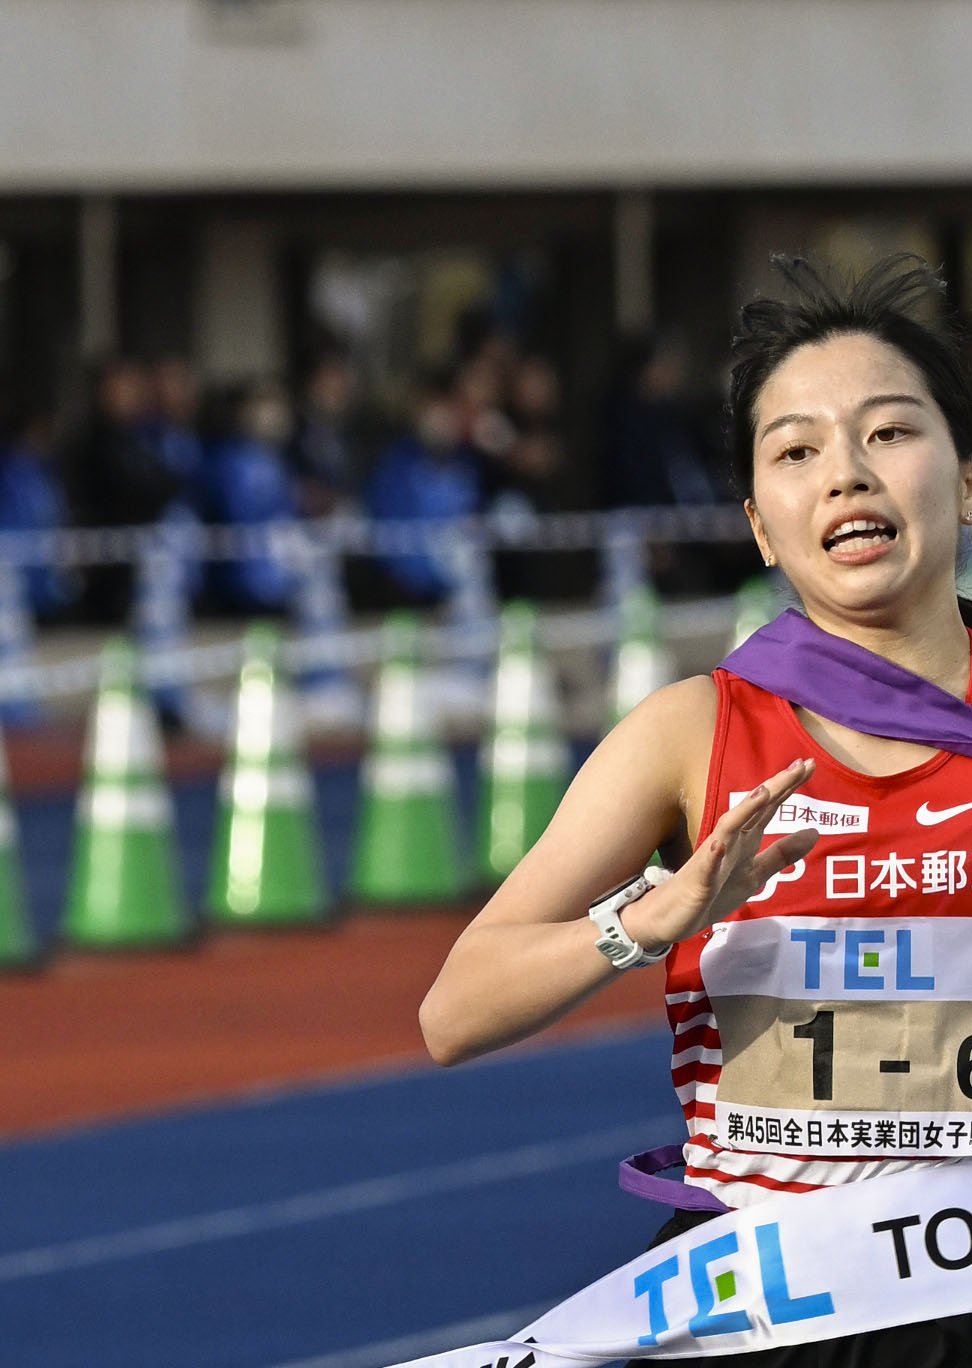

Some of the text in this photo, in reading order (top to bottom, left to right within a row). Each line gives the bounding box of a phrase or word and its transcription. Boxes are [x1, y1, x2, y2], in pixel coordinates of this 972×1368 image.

[779, 803, 861, 828] 日本郵便
[790, 929, 935, 990] TEL
[634, 1222, 835, 1346] TEL
